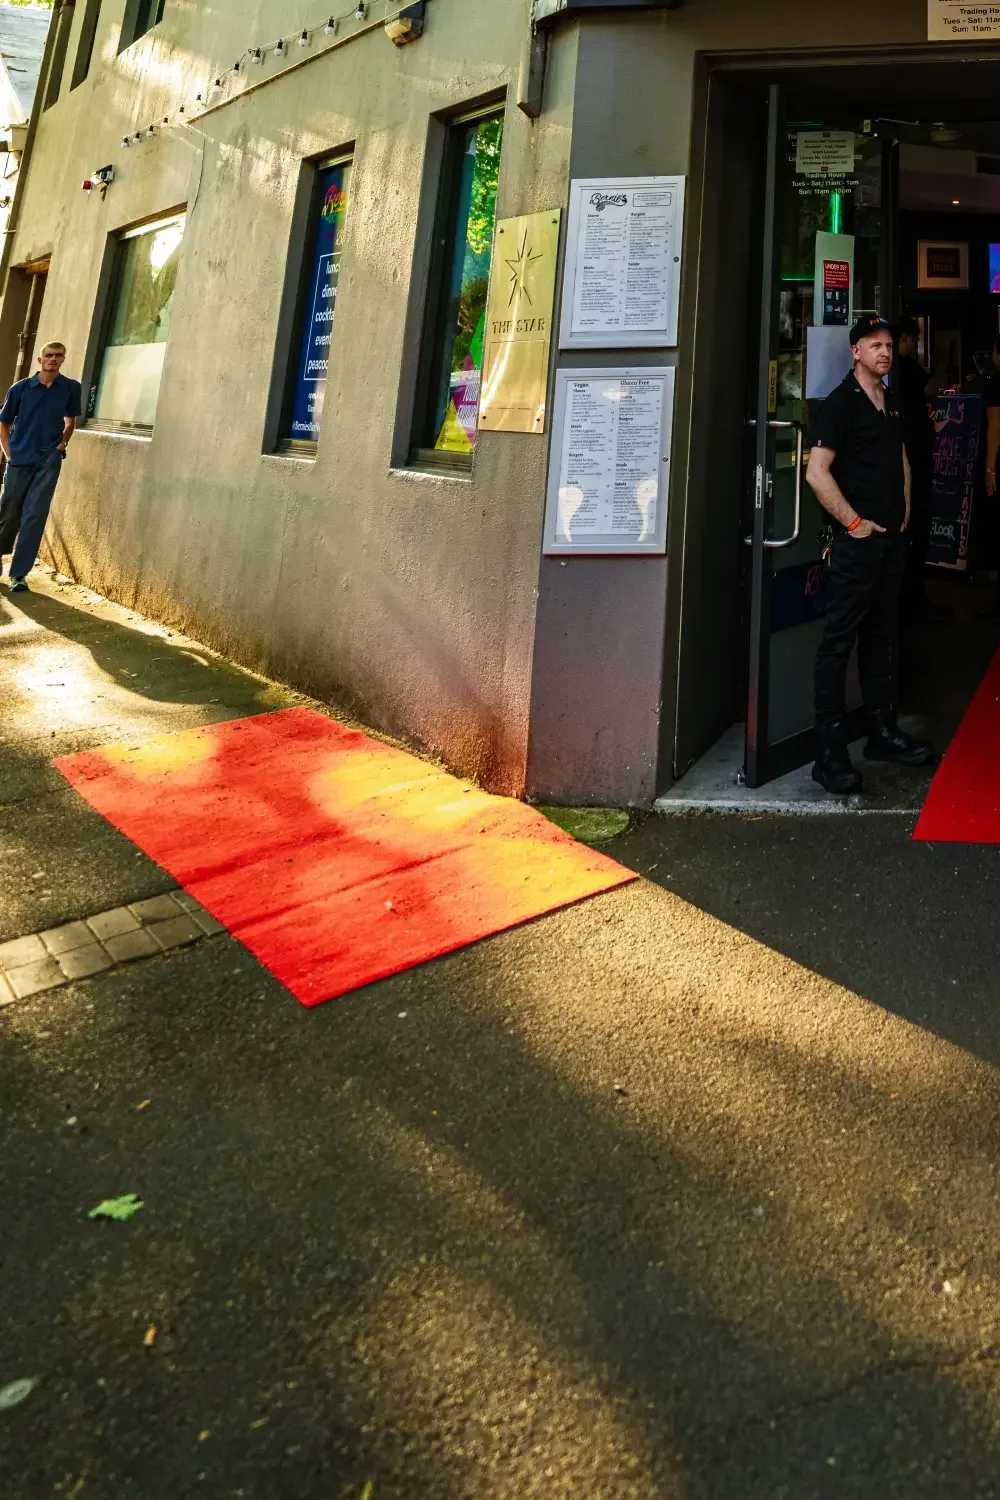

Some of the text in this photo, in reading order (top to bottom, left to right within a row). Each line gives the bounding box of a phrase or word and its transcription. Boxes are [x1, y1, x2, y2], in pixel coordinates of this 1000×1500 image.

[960, 8, 987, 16] Trading
[326, 261, 340, 275] lunc
[322, 284, 338, 298] dinne
[315, 308, 334, 322] cockta
[492, 318, 545, 335] THE STAR
[315, 333, 332, 346] event
[308, 359, 329, 374] peacoc
